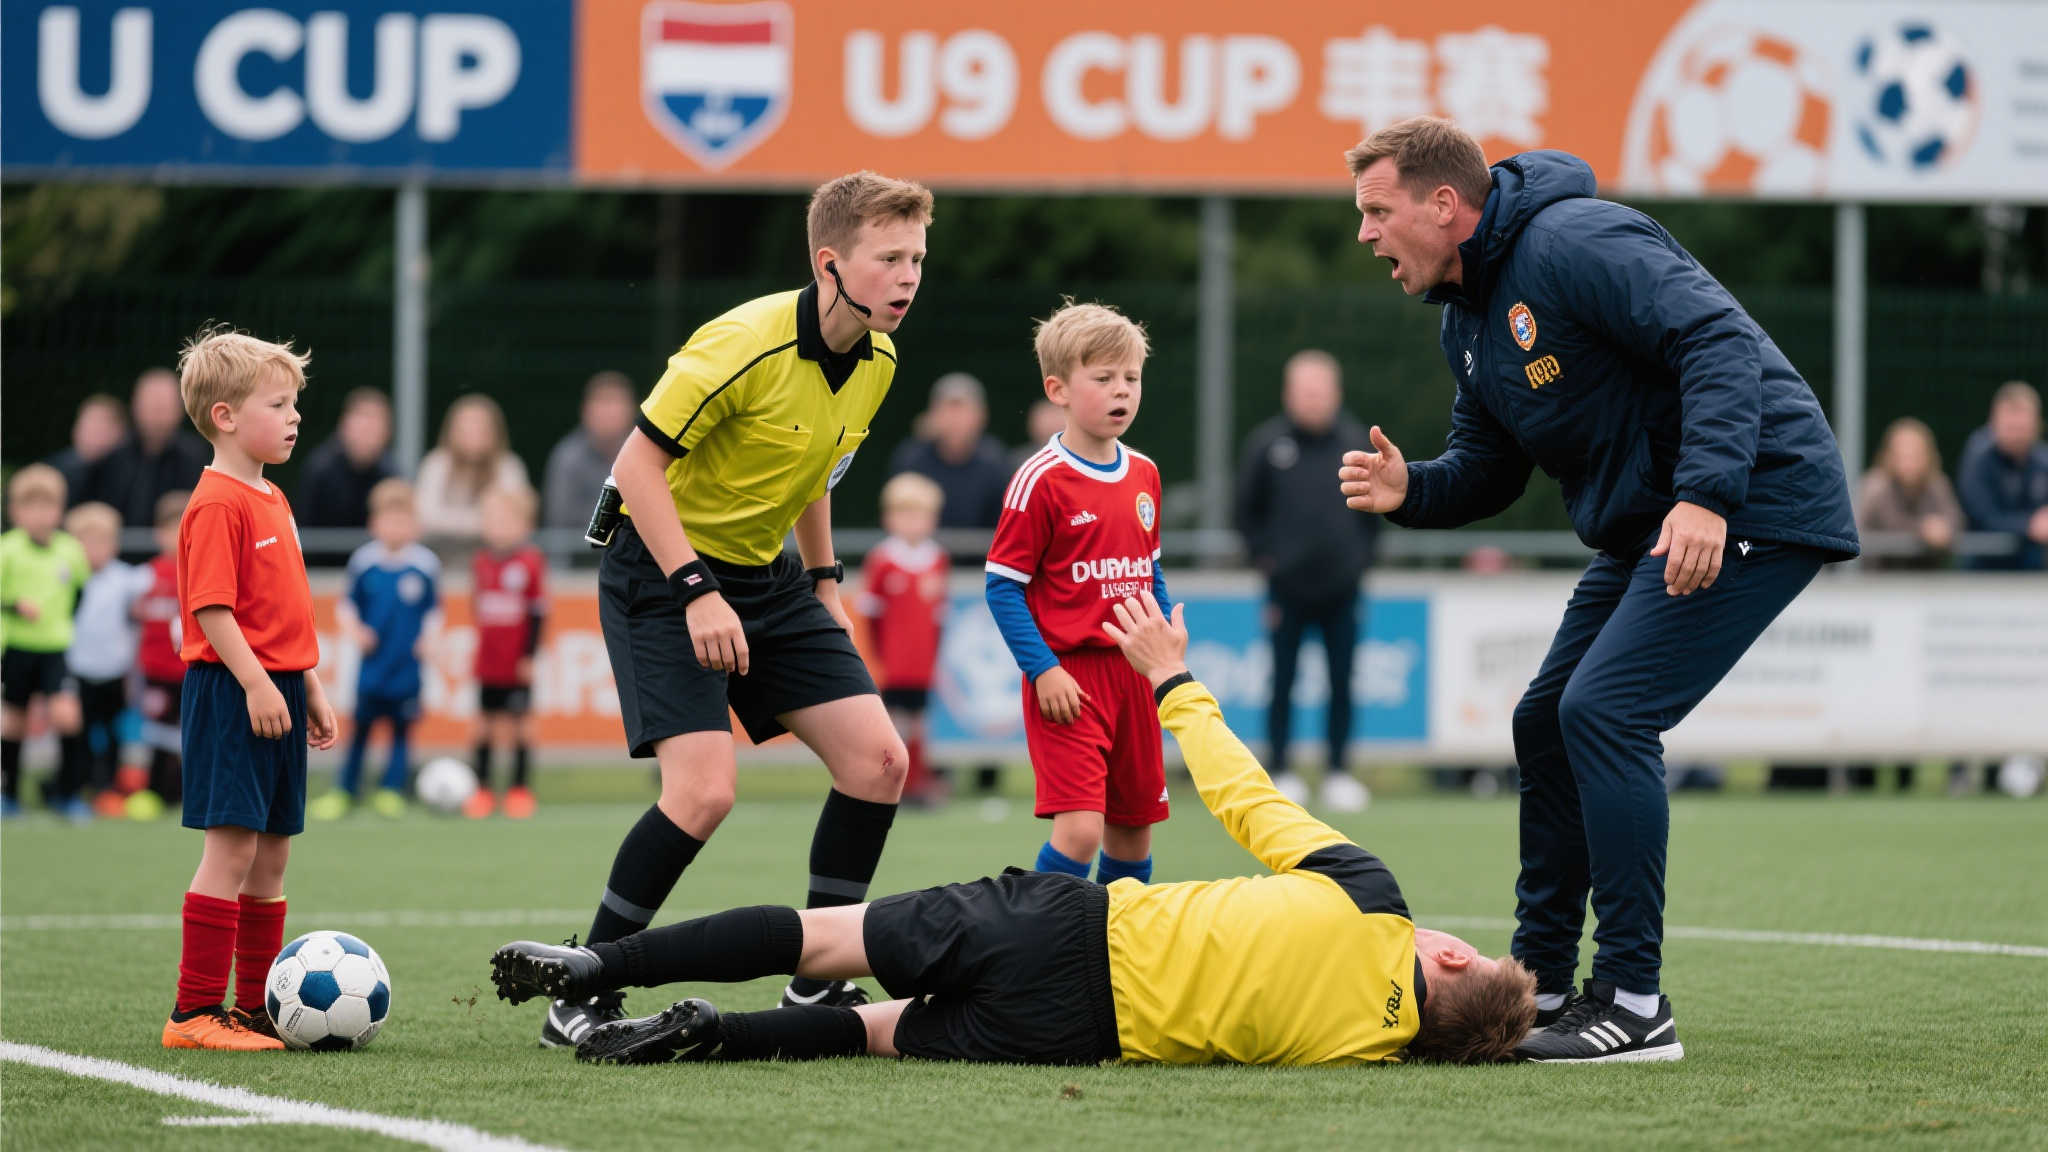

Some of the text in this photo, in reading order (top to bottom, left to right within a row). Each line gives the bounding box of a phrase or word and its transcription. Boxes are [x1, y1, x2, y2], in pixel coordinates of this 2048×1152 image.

[38, 6, 521, 142] U CUP
[843, 29, 1302, 141] U9 CUP
